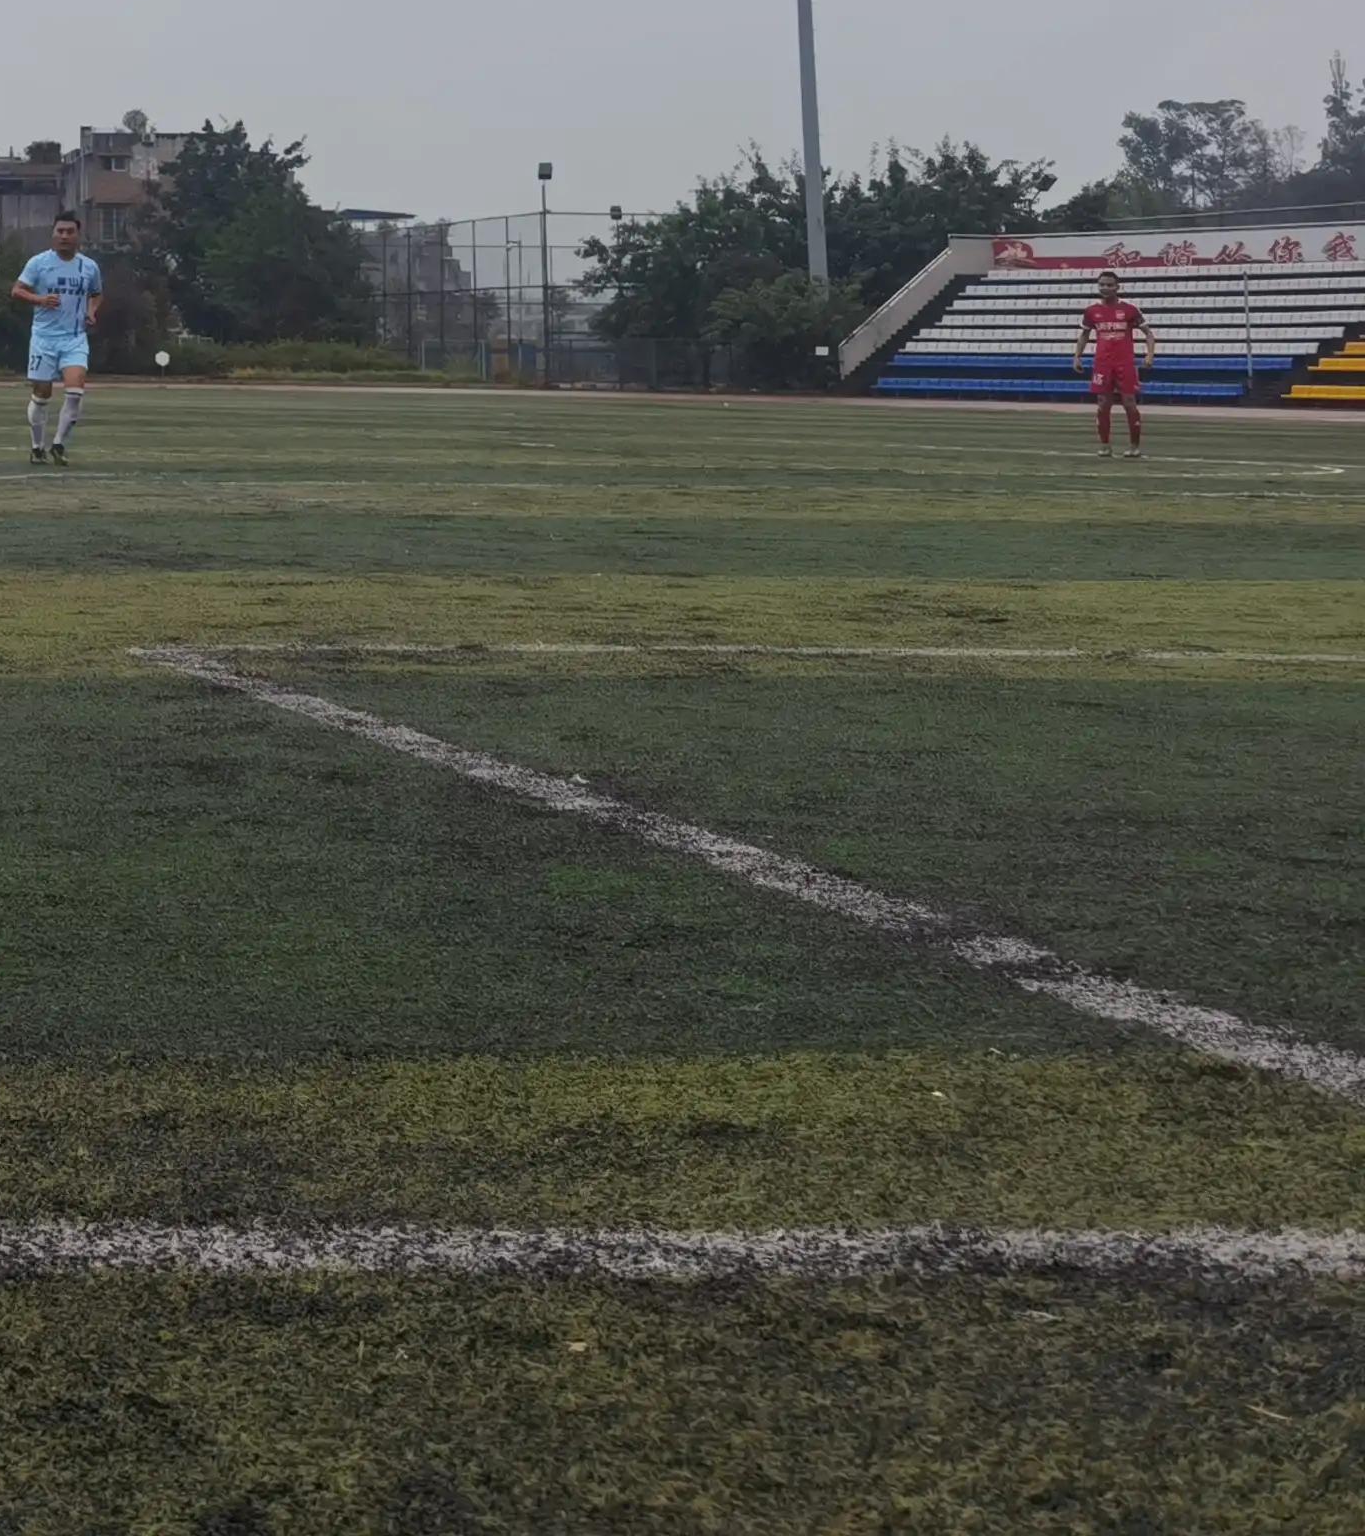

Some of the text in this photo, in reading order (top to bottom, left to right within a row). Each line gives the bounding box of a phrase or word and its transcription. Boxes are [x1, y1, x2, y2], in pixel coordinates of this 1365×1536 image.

[1103, 231, 1359, 268] 和谐从你我
[30, 355, 42, 371] 27
